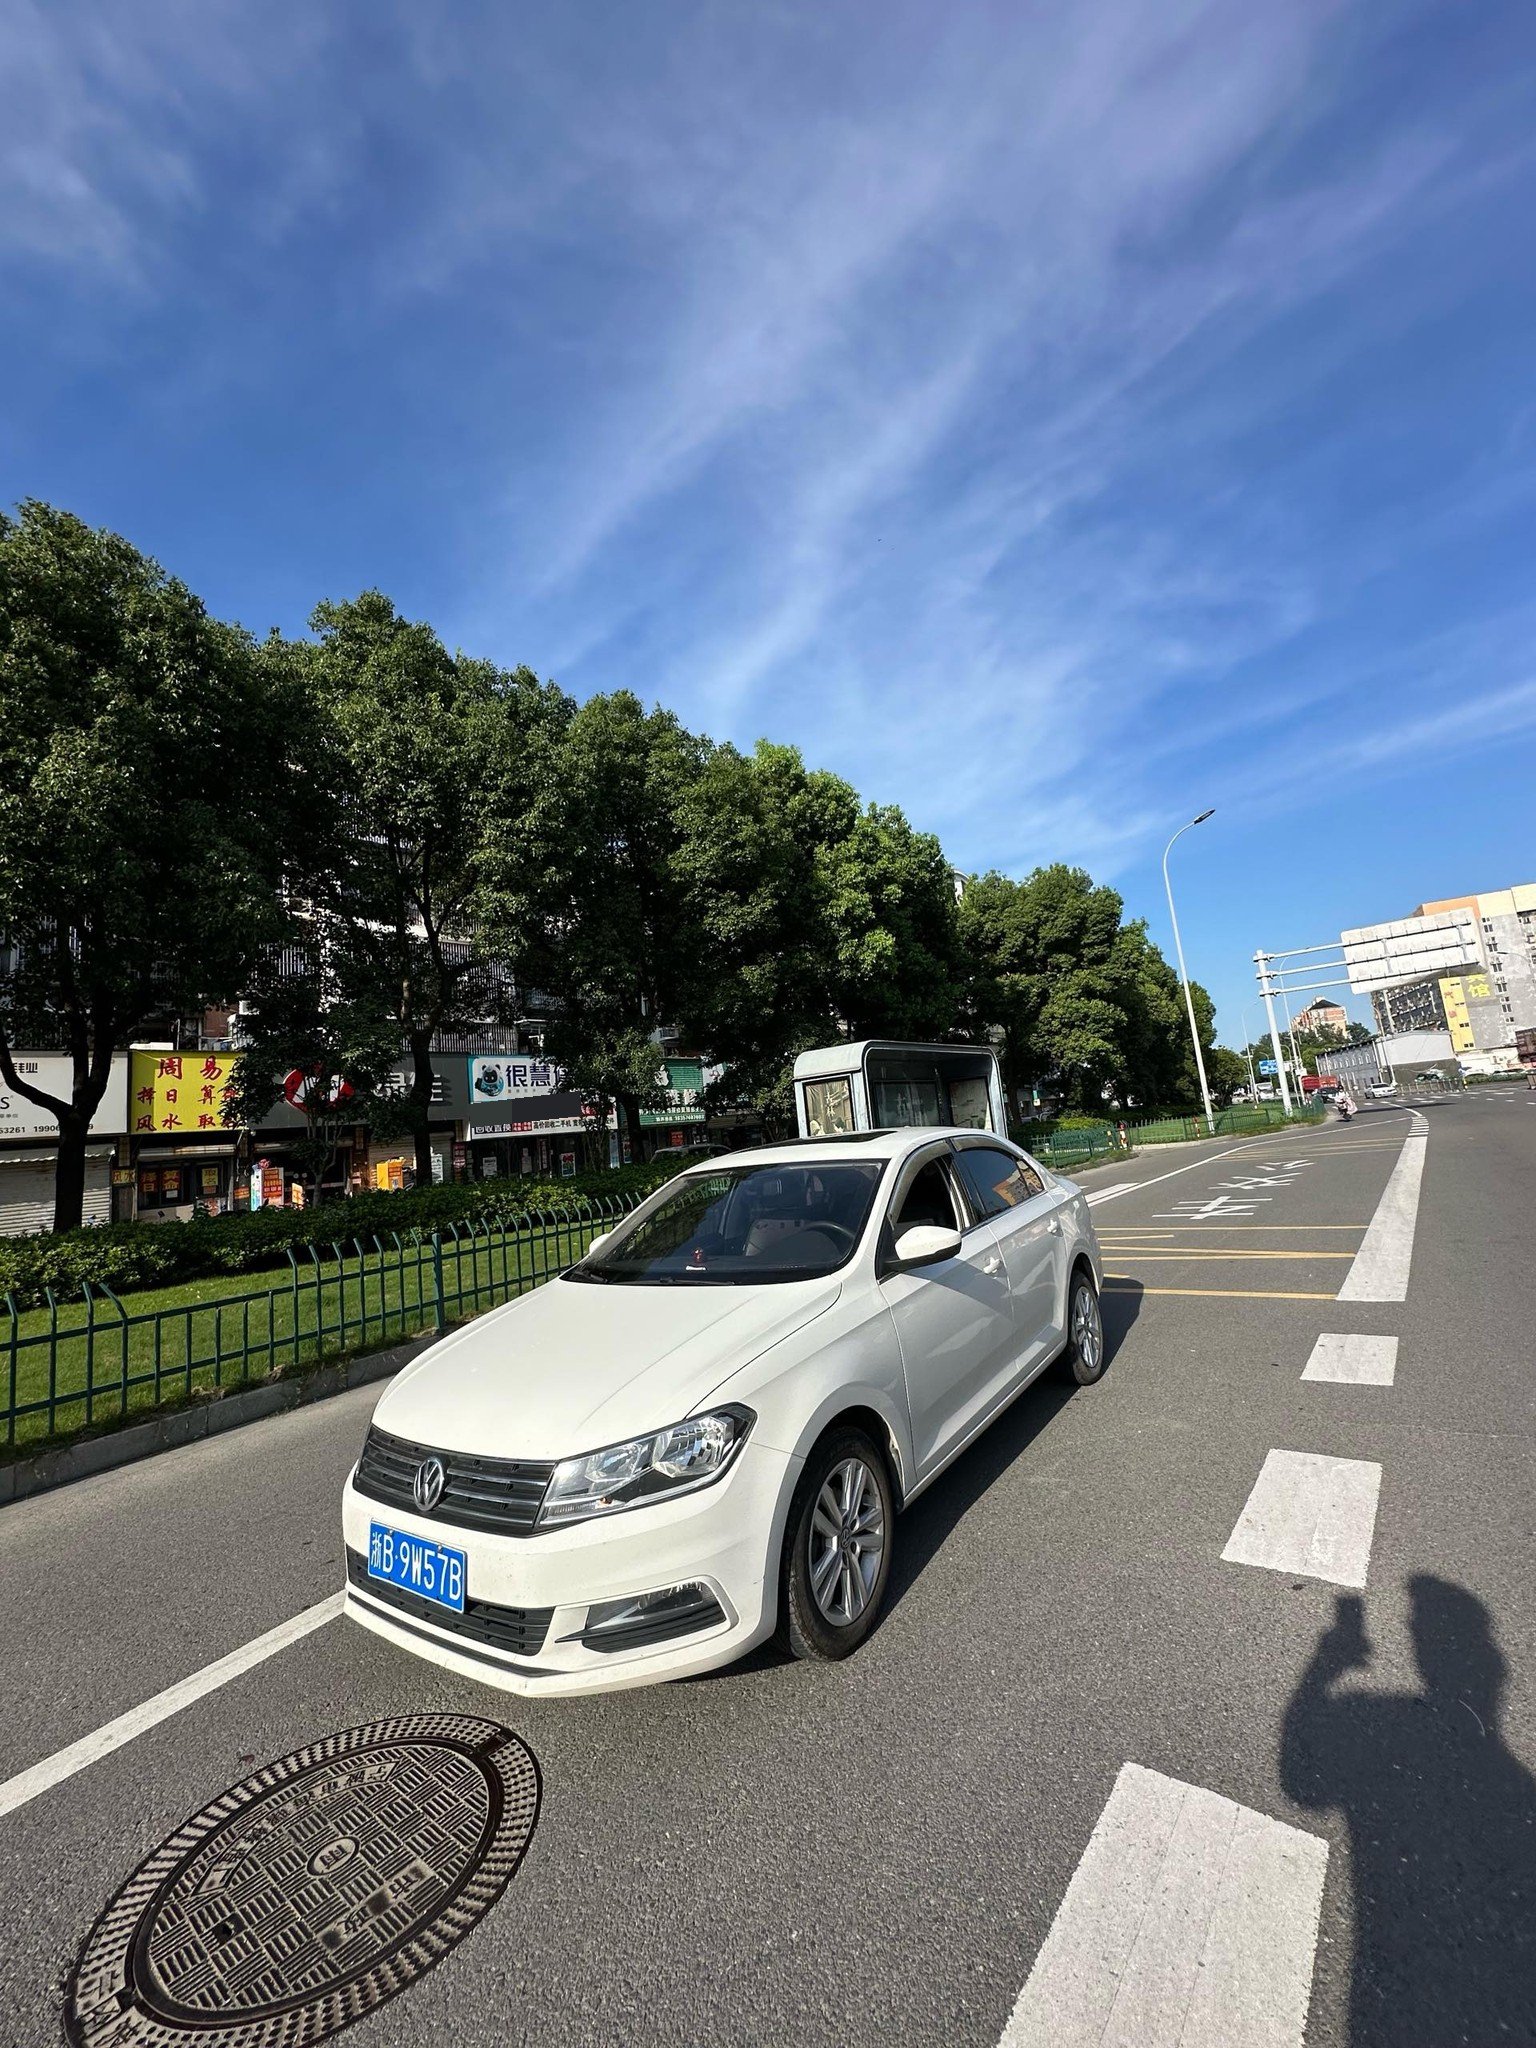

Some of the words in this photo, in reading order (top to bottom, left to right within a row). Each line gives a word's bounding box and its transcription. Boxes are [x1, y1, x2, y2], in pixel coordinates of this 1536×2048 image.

[157, 1055, 223, 1081] 周易
[136, 1086, 178, 1106] 择日
[136, 1112, 183, 1132] 风水
[1151, 1158, 1315, 1220] 公交车
